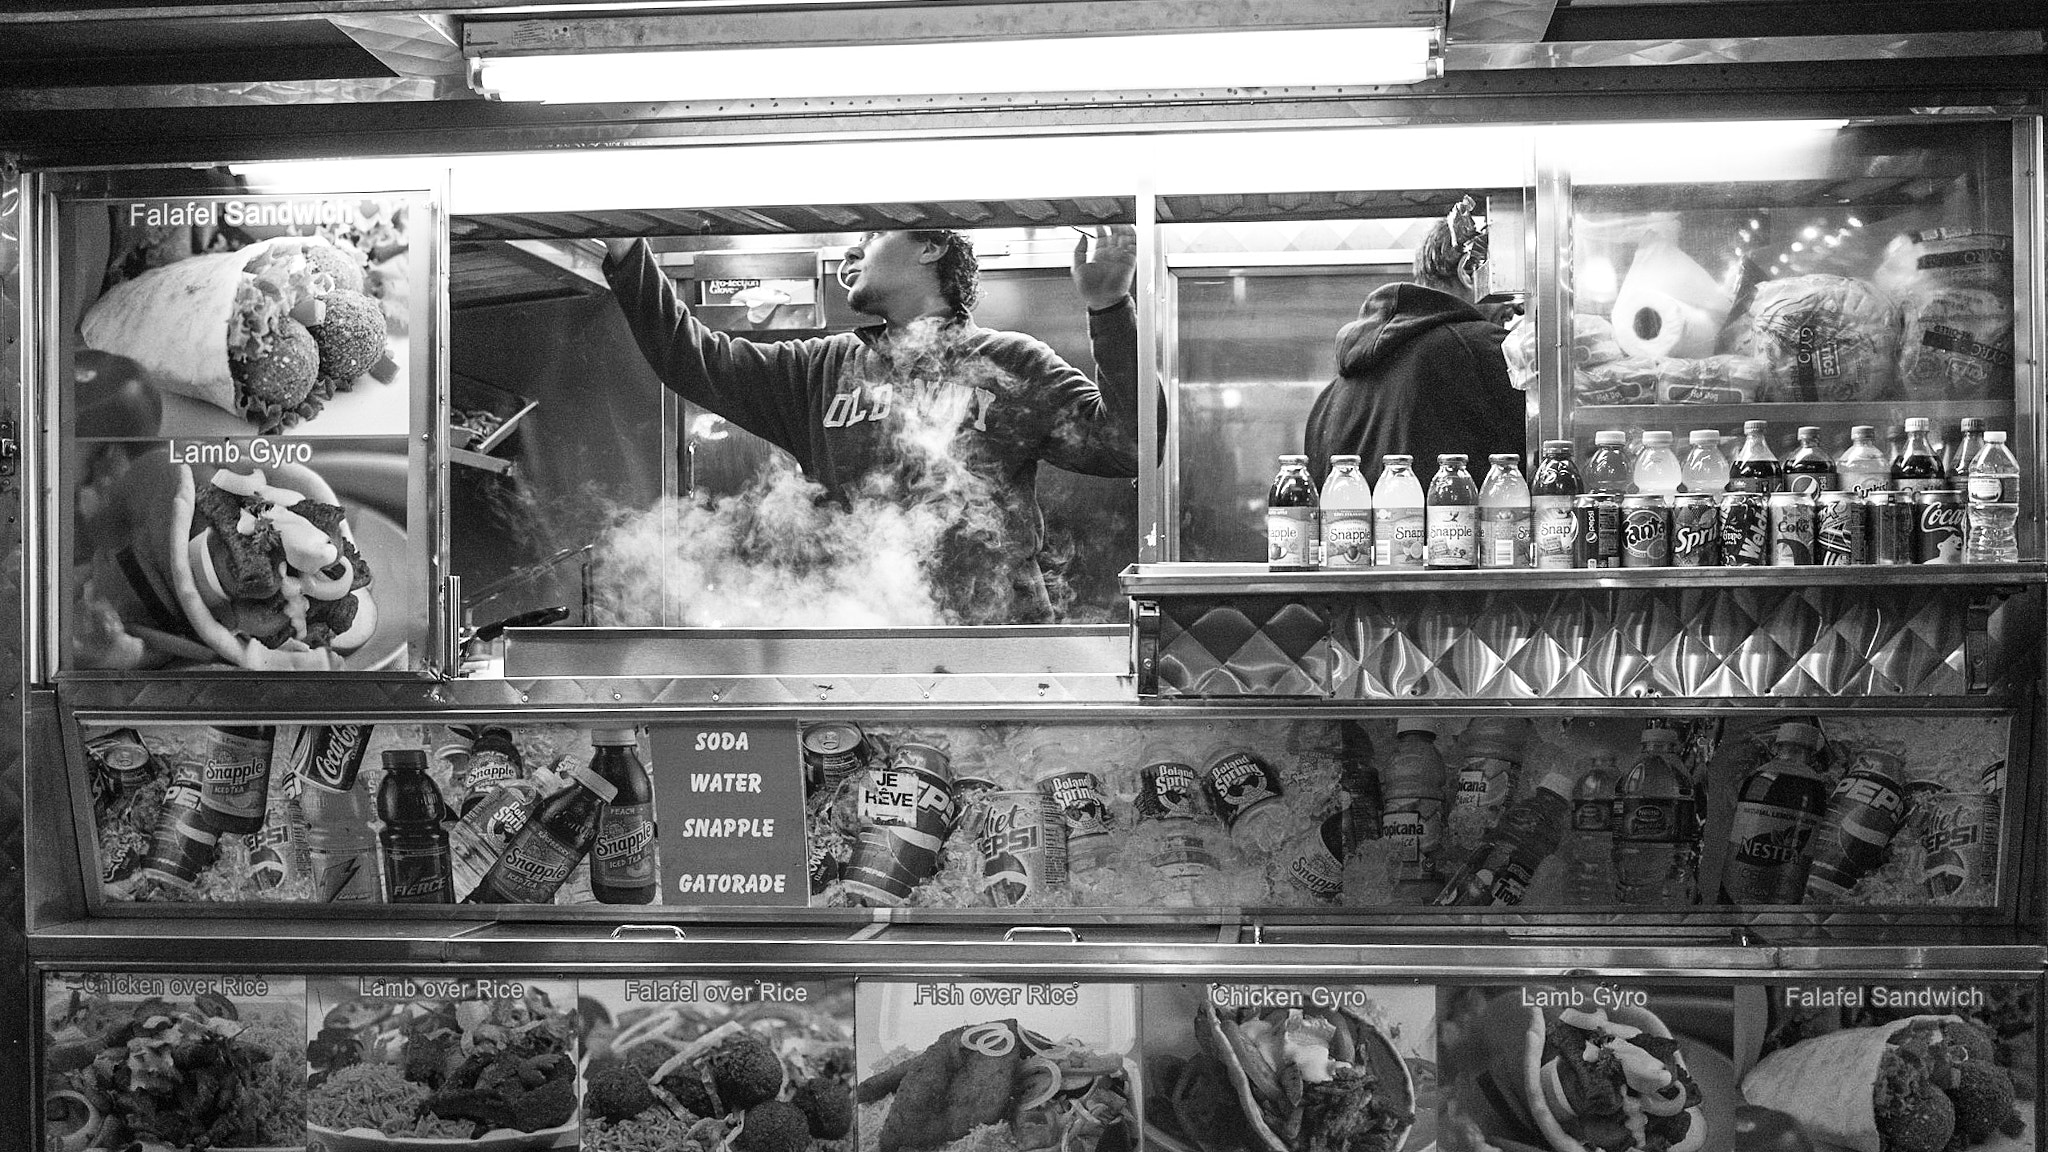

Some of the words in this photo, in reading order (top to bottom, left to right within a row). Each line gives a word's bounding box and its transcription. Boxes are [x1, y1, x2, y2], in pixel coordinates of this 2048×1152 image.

[130, 201, 218, 226] Falafel
[224, 200, 354, 226] Sandwich
[823, 383, 893, 428] OLD
[169, 438, 240, 464] Lamb
[250, 438, 312, 469] Gyro
[1540, 523, 1571, 537] Snap
[1587, 510, 1596, 532] pepsi
[1778, 518, 1810, 534] Coke
[1330, 528, 1371, 543] Snapple
[1395, 526, 1424, 542] Snap
[1430, 525, 1472, 540] Snapple
[694, 731, 749, 751] SODA
[206, 757, 264, 784] Snapple
[467, 764, 515, 784] Snapple
[1158, 764, 1194, 779] Poland
[1212, 754, 1250, 779] Poland
[690, 773, 762, 793] WATER
[876, 772, 898, 788] JE
[1214, 763, 1265, 797] Spring
[610, 807, 635, 816] PEACH
[243, 825, 288, 852] EPSI
[682, 818, 774, 838] SNAPPLE
[1381, 821, 1424, 838] ropicana
[596, 821, 653, 857] Snapple
[980, 825, 1038, 859] EPSI
[1921, 825, 1978, 854] EPSI
[1740, 837, 1799, 864] NESTEA
[505, 847, 567, 879] Snapple
[609, 860, 626, 869] ICED
[1291, 856, 1343, 891] Snappl
[394, 877, 447, 896] FIERCE
[678, 873, 786, 894] GATORADE
[84, 975, 164, 995] Chicken
[170, 979, 217, 995] over
[222, 976, 268, 996] Rice
[360, 978, 416, 998] Lamb
[423, 981, 469, 998] over
[476, 979, 525, 998] Rice
[625, 981, 698, 1002] Falafel
[704, 986, 753, 1002] over
[760, 982, 808, 1002] Rice
[917, 983, 964, 1006] Fish
[970, 987, 1022, 1006] over
[1027, 983, 1078, 1006] Rice
[1212, 986, 1303, 1007] Chicken
[1311, 986, 1366, 1012] Gyro
[1522, 986, 1584, 1006] Lamb
[1593, 986, 1647, 1011] Gyro
[1786, 986, 1863, 1007] Falafel
[1870, 986, 1984, 1008] Sandwich
